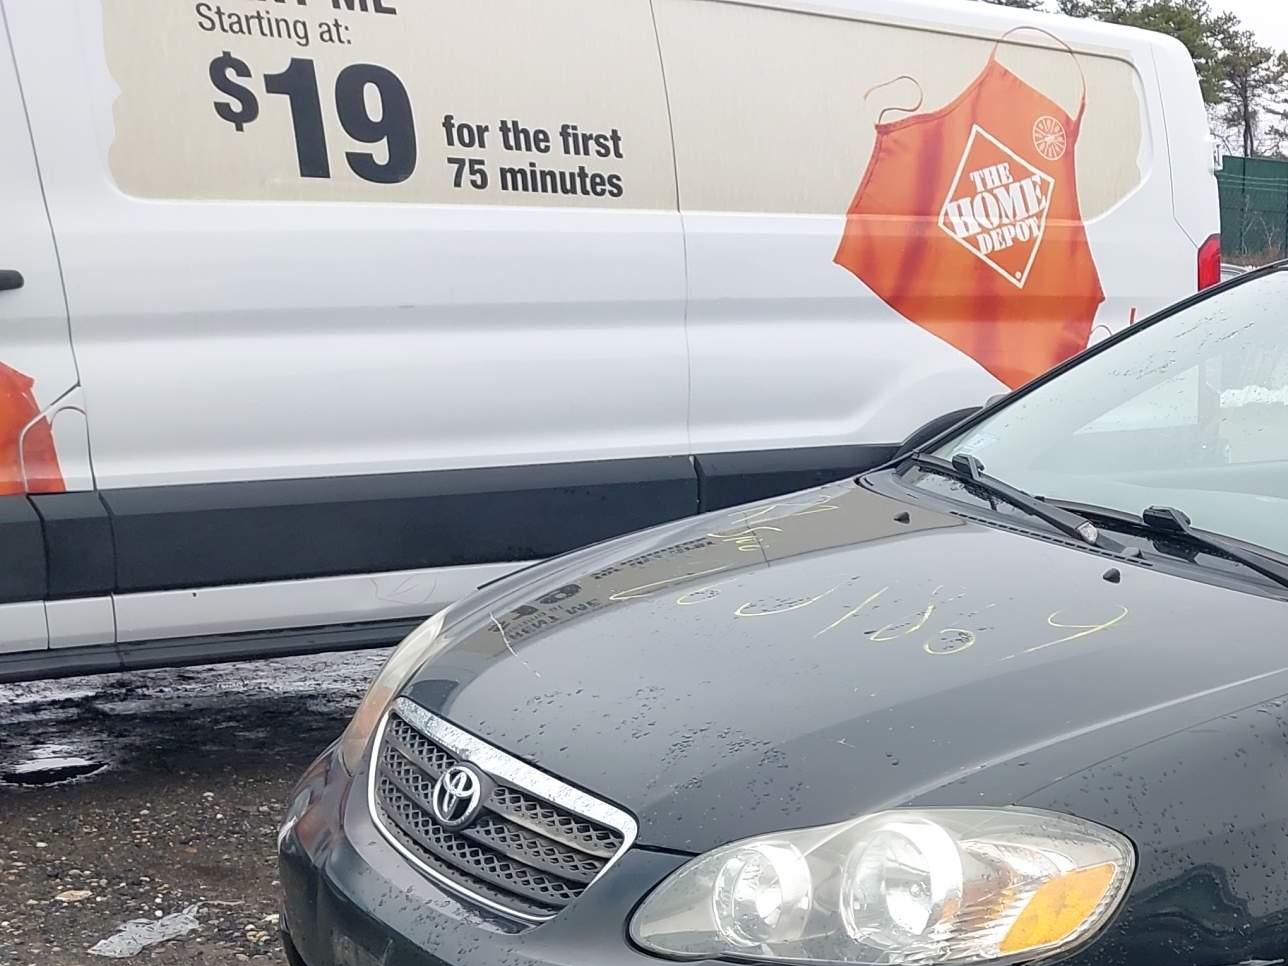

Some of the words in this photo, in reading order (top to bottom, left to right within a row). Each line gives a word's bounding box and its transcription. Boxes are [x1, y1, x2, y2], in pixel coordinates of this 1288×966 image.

[195, 3, 310, 46] Starting
[318, 18, 352, 45] at:
[442, 115, 489, 149] for
[499, 120, 551, 154] the
[559, 124, 624, 159] first
[447, 157, 489, 190] 75
[499, 162, 624, 198] minutes
[969, 163, 1013, 193] THE
[946, 174, 1047, 239] HOME
[976, 216, 1040, 256] DEPOT
